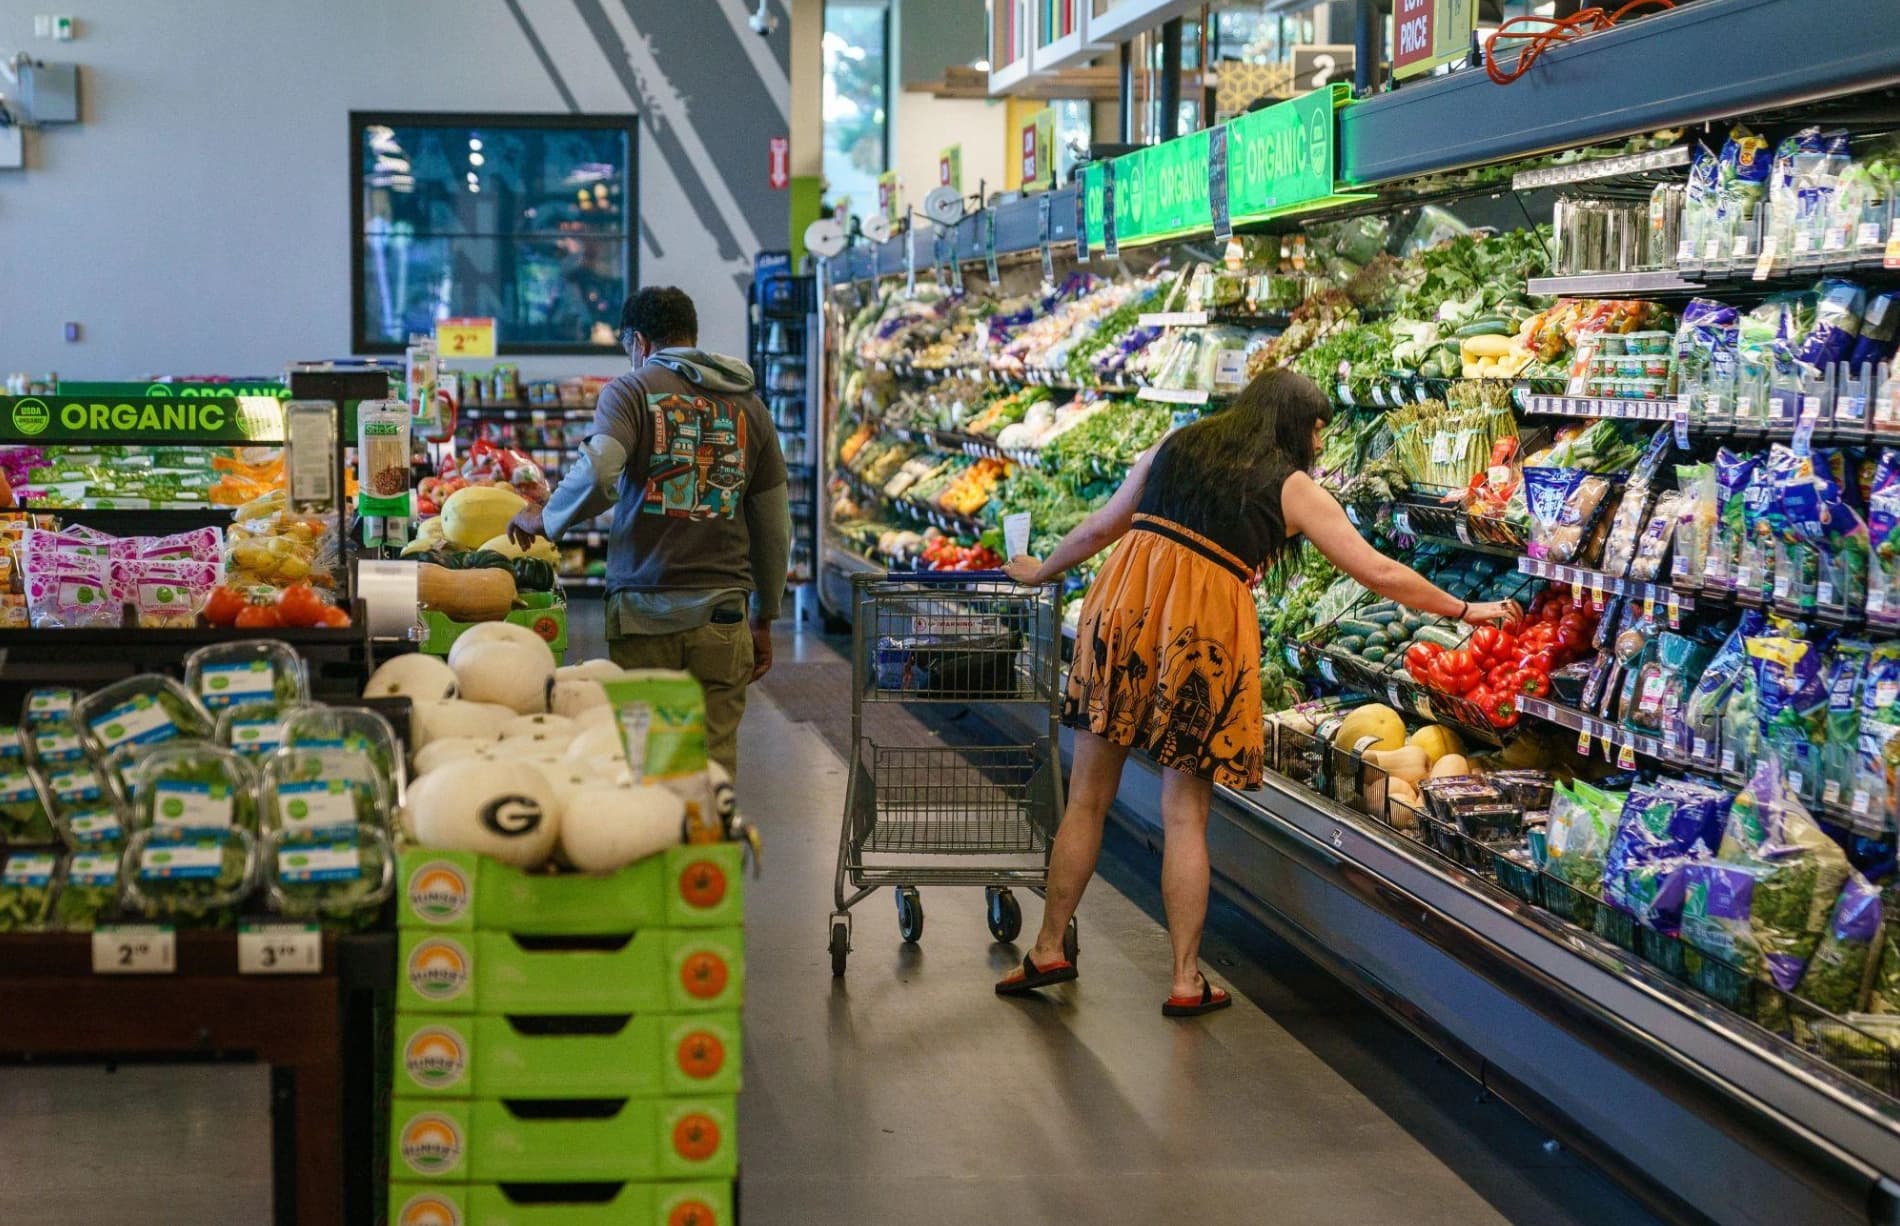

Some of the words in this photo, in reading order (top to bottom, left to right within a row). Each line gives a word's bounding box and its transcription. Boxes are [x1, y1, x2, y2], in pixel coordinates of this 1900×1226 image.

[1400, 14, 1428, 55] PRICE
[1247, 123, 1307, 184] ORGANIC
[60, 403, 225, 431] ORGANIC
[478, 794, 542, 837] G
